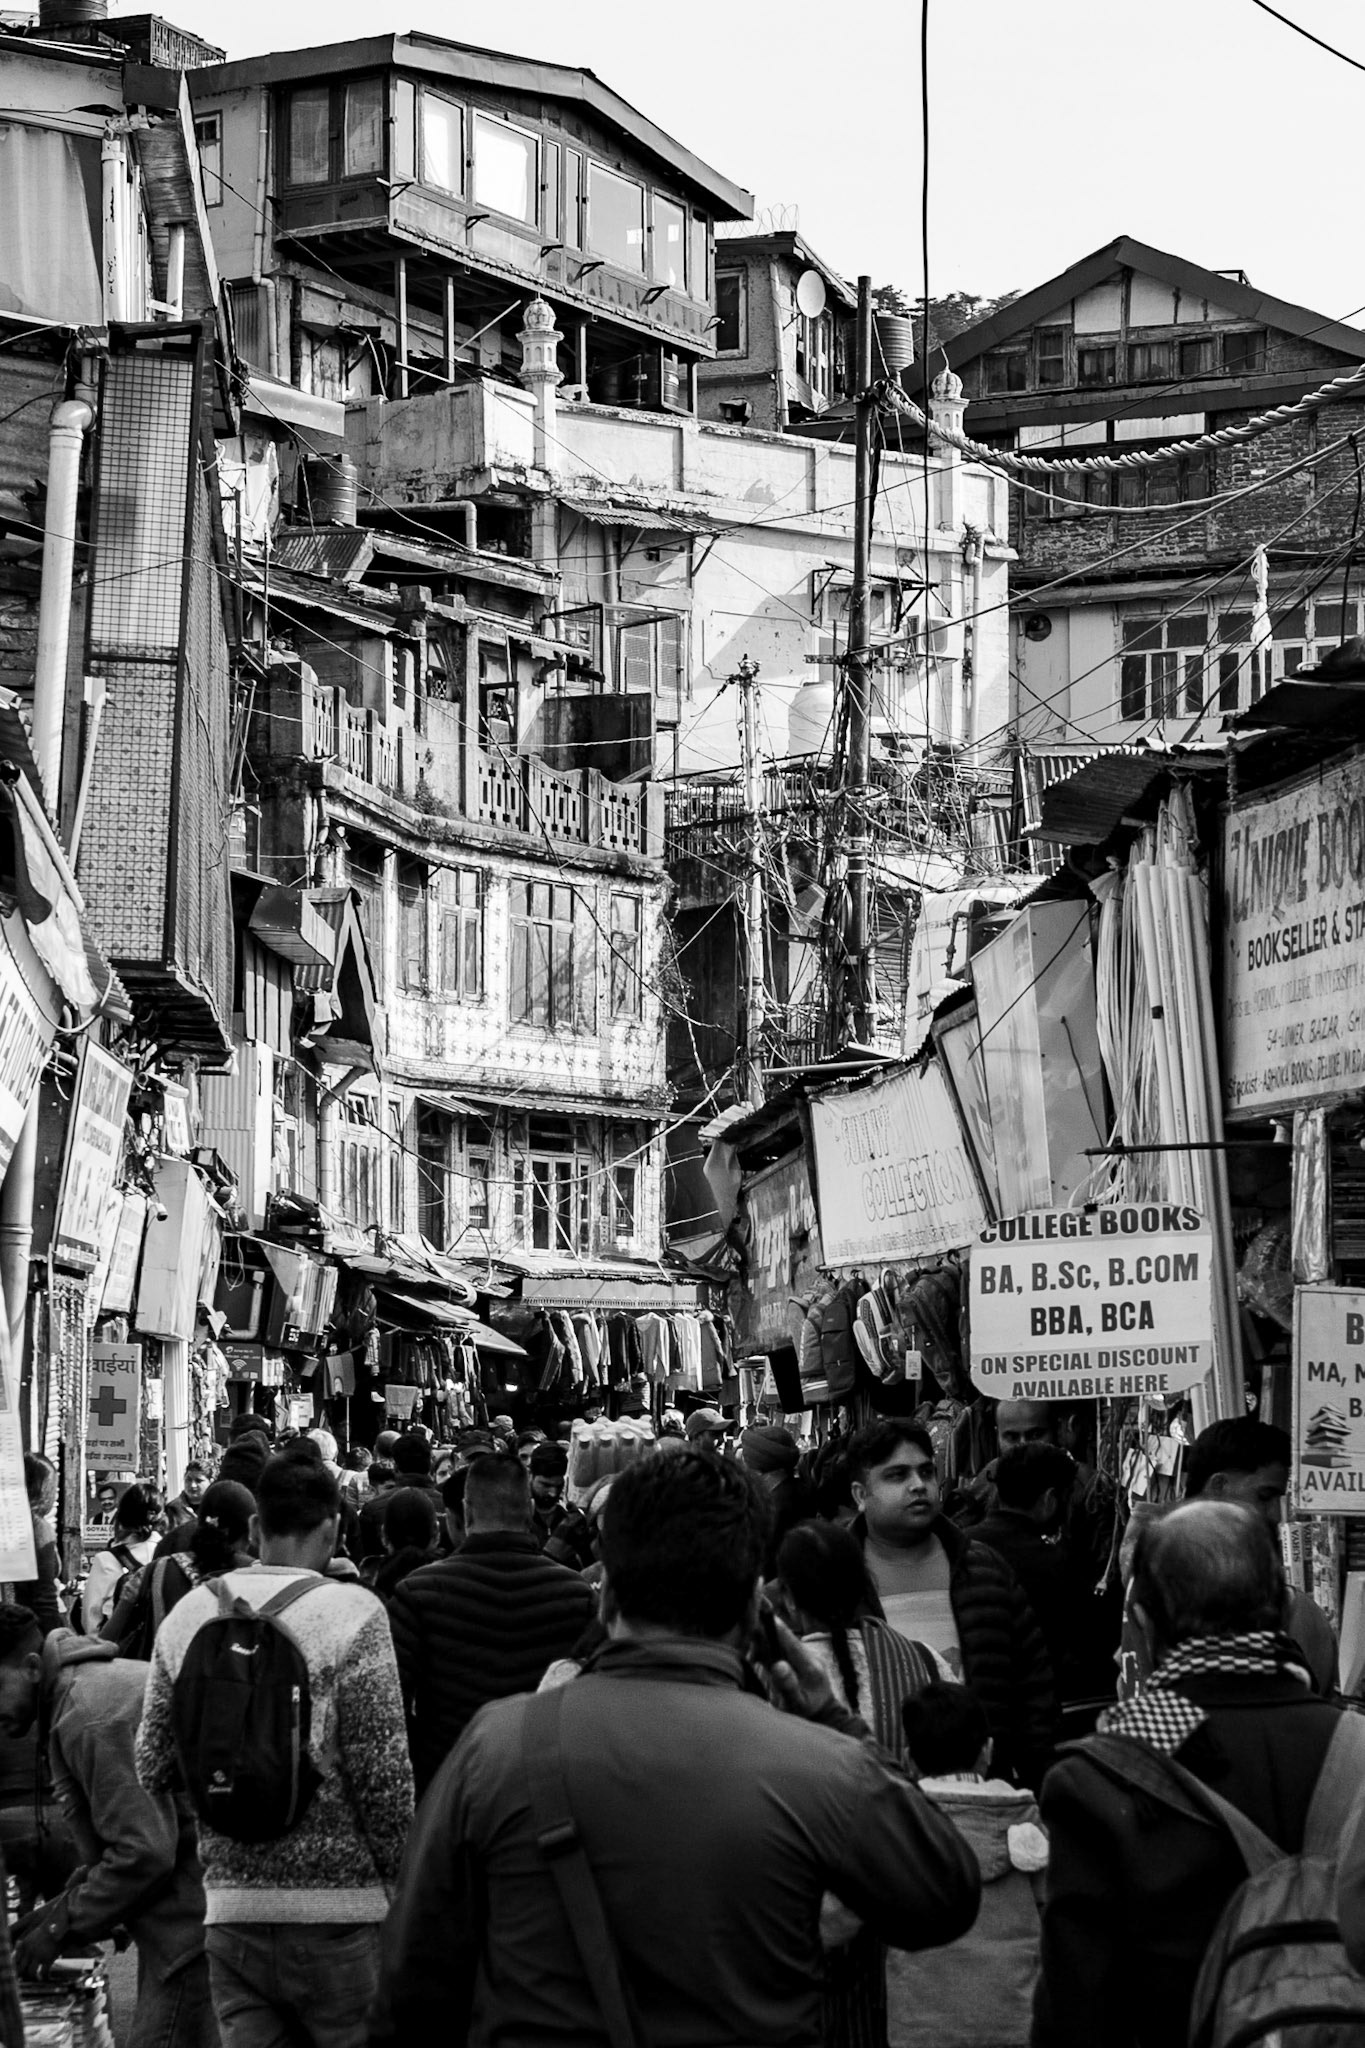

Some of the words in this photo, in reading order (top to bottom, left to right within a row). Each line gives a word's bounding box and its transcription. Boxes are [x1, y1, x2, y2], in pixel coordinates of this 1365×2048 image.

[1248, 915, 1328, 971] BOOKSELLER
[1332, 910, 1341, 945] &
[861, 1146, 975, 1224] COLLECTION
[979, 1212, 1093, 1244] COLLEGE
[1100, 1206, 1201, 1235] BOOKS
[980, 1264, 1023, 1296] BA,
[1031, 1260, 1101, 1292] B.Sc,
[1108, 1252, 1199, 1287] B.COM
[1030, 1304, 1093, 1337] BBA,
[1101, 1300, 1155, 1332] BCA
[981, 1356, 1007, 1376] ON
[1012, 1352, 1093, 1373] SPECIAL
[1098, 1345, 1200, 1369] DISCOUNT
[1307, 1361, 1347, 1388] MA,
[1011, 1376, 1115, 1398] AVAILABLE
[1119, 1373, 1169, 1394] HERE
